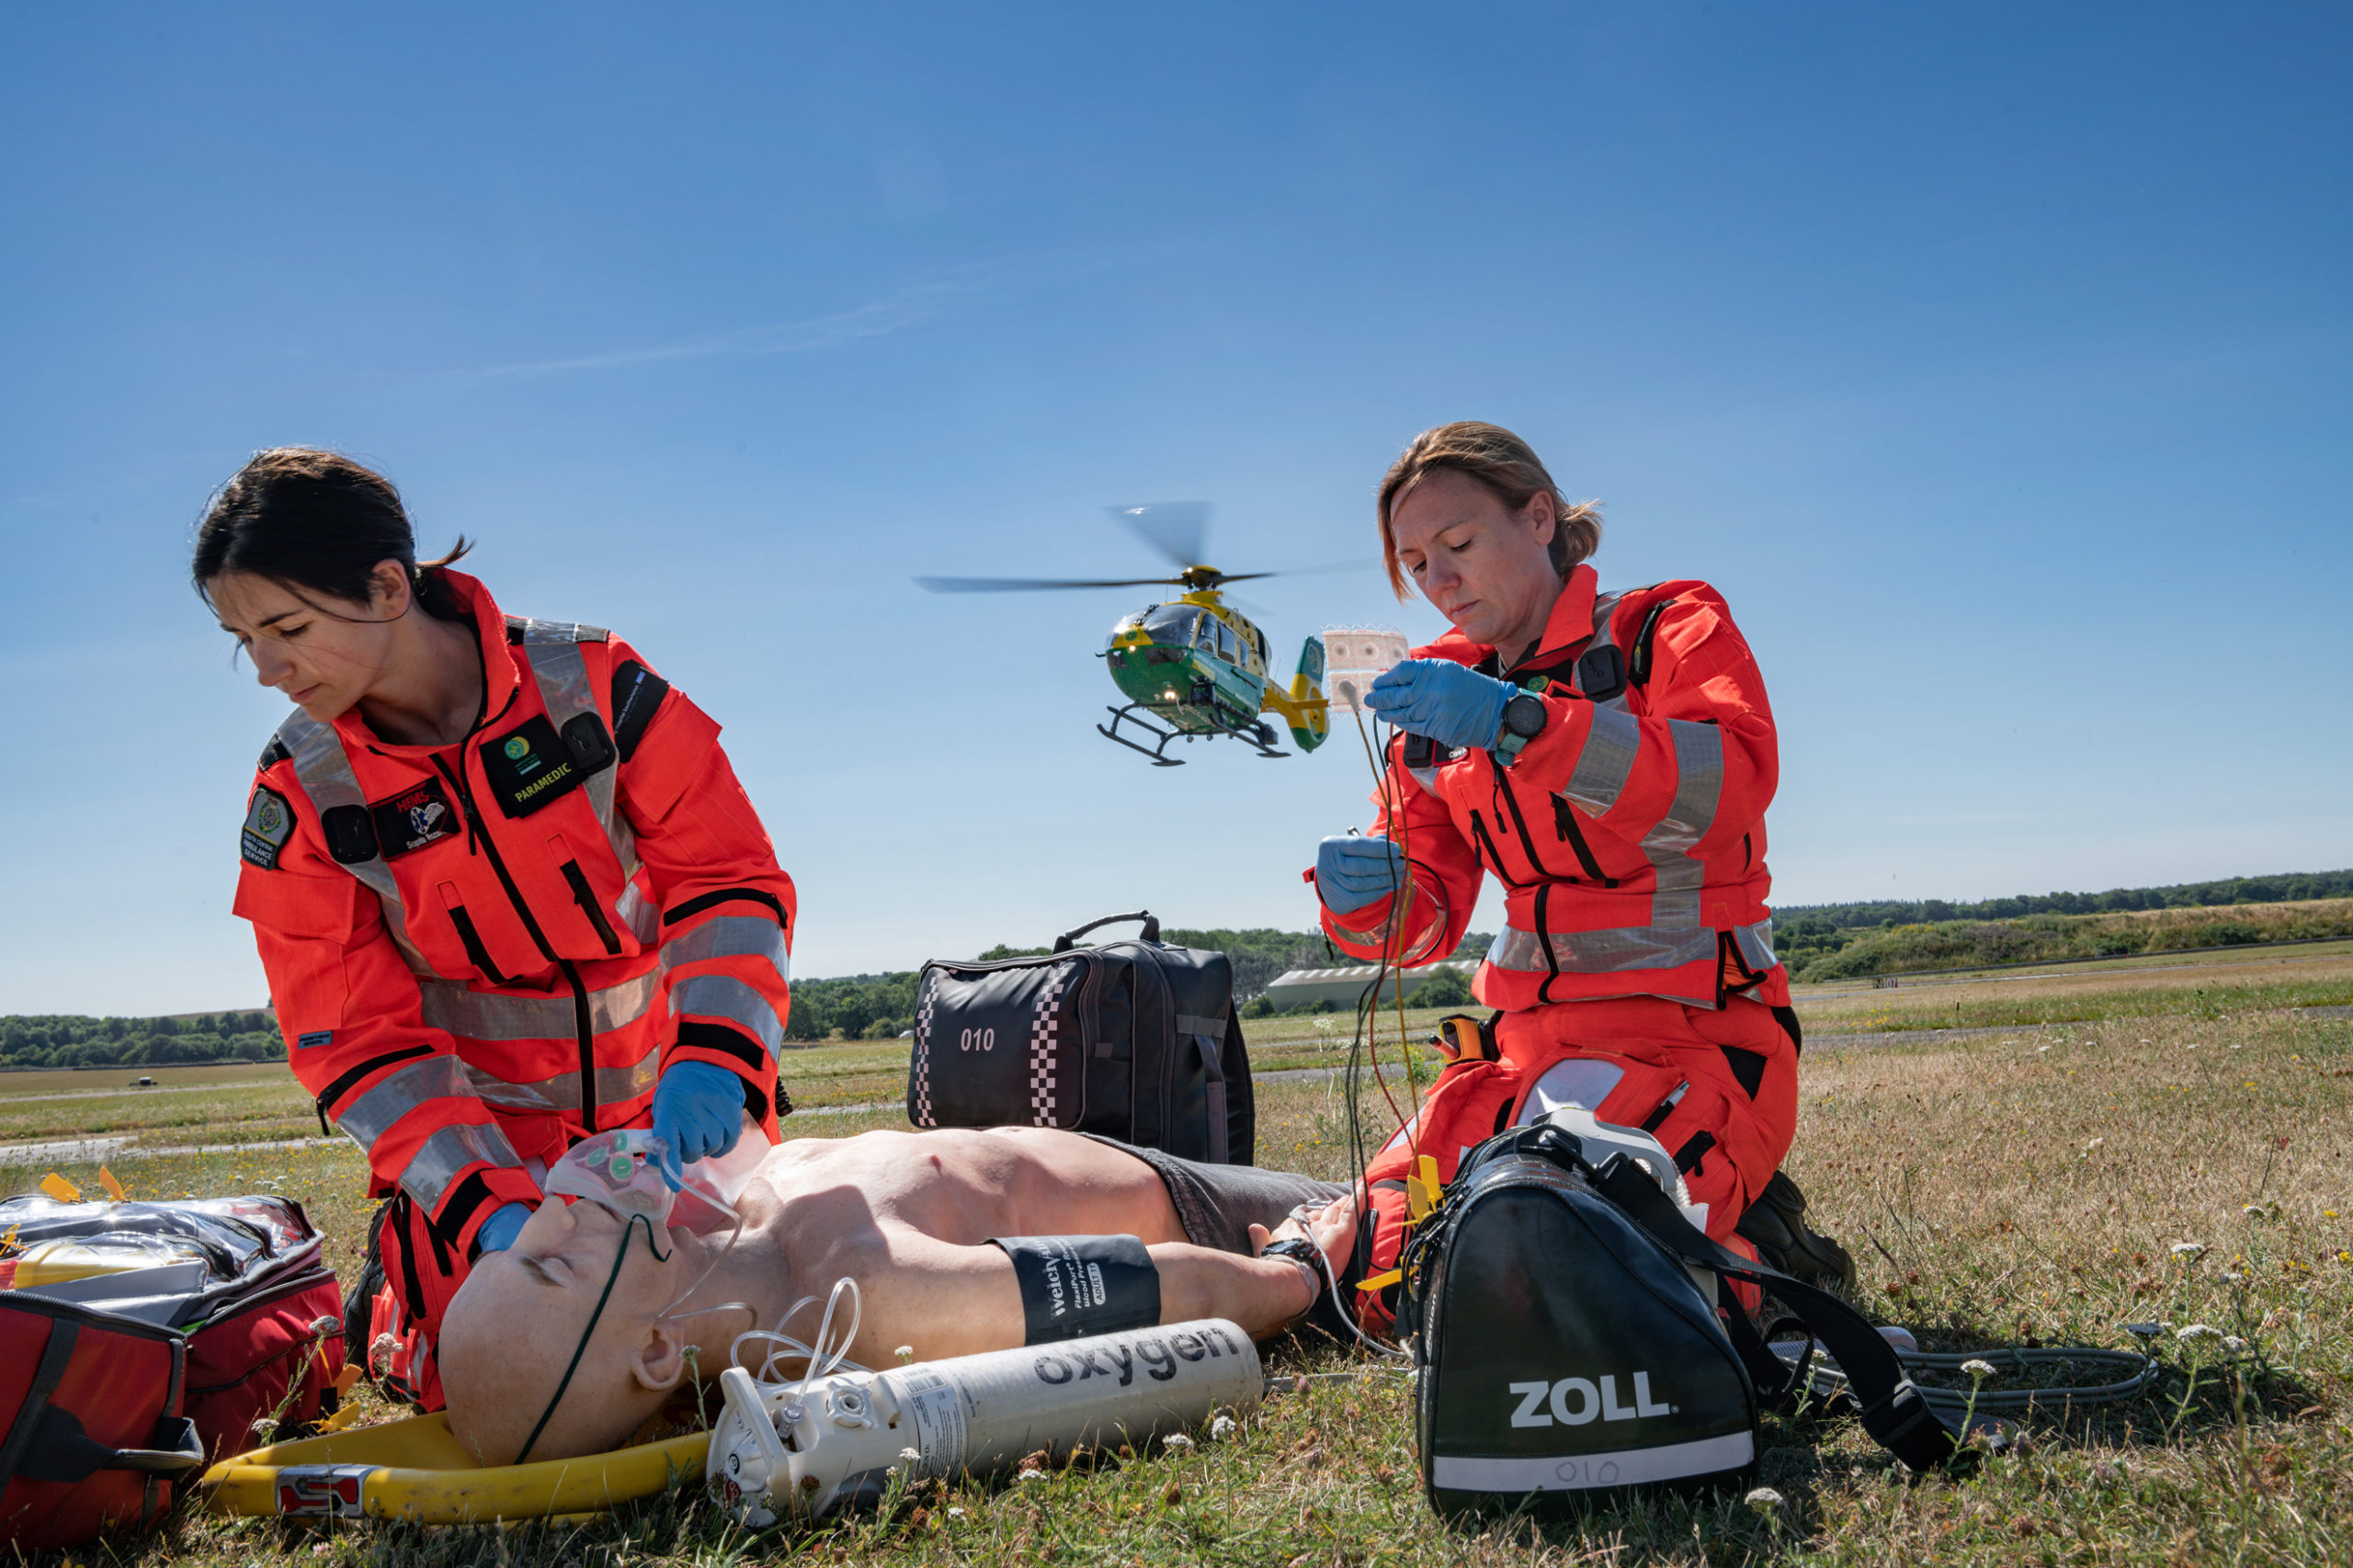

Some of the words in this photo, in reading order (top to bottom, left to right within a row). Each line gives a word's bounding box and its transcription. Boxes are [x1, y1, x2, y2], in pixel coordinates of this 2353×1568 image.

[515, 762, 572, 802] PARAMEDIC
[396, 790, 429, 813] HEMS
[244, 839, 273, 860] AMBULANCE
[244, 848, 268, 867] SERVICE
[961, 1028, 995, 1051] 010
[1069, 1246, 1086, 1278] Pressure
[1080, 1280, 1091, 1307] Blood
[1091, 1274, 1103, 1301] ADULT
[1034, 1327, 1240, 1387] oxygen
[1555, 1460, 1620, 1484] 010
